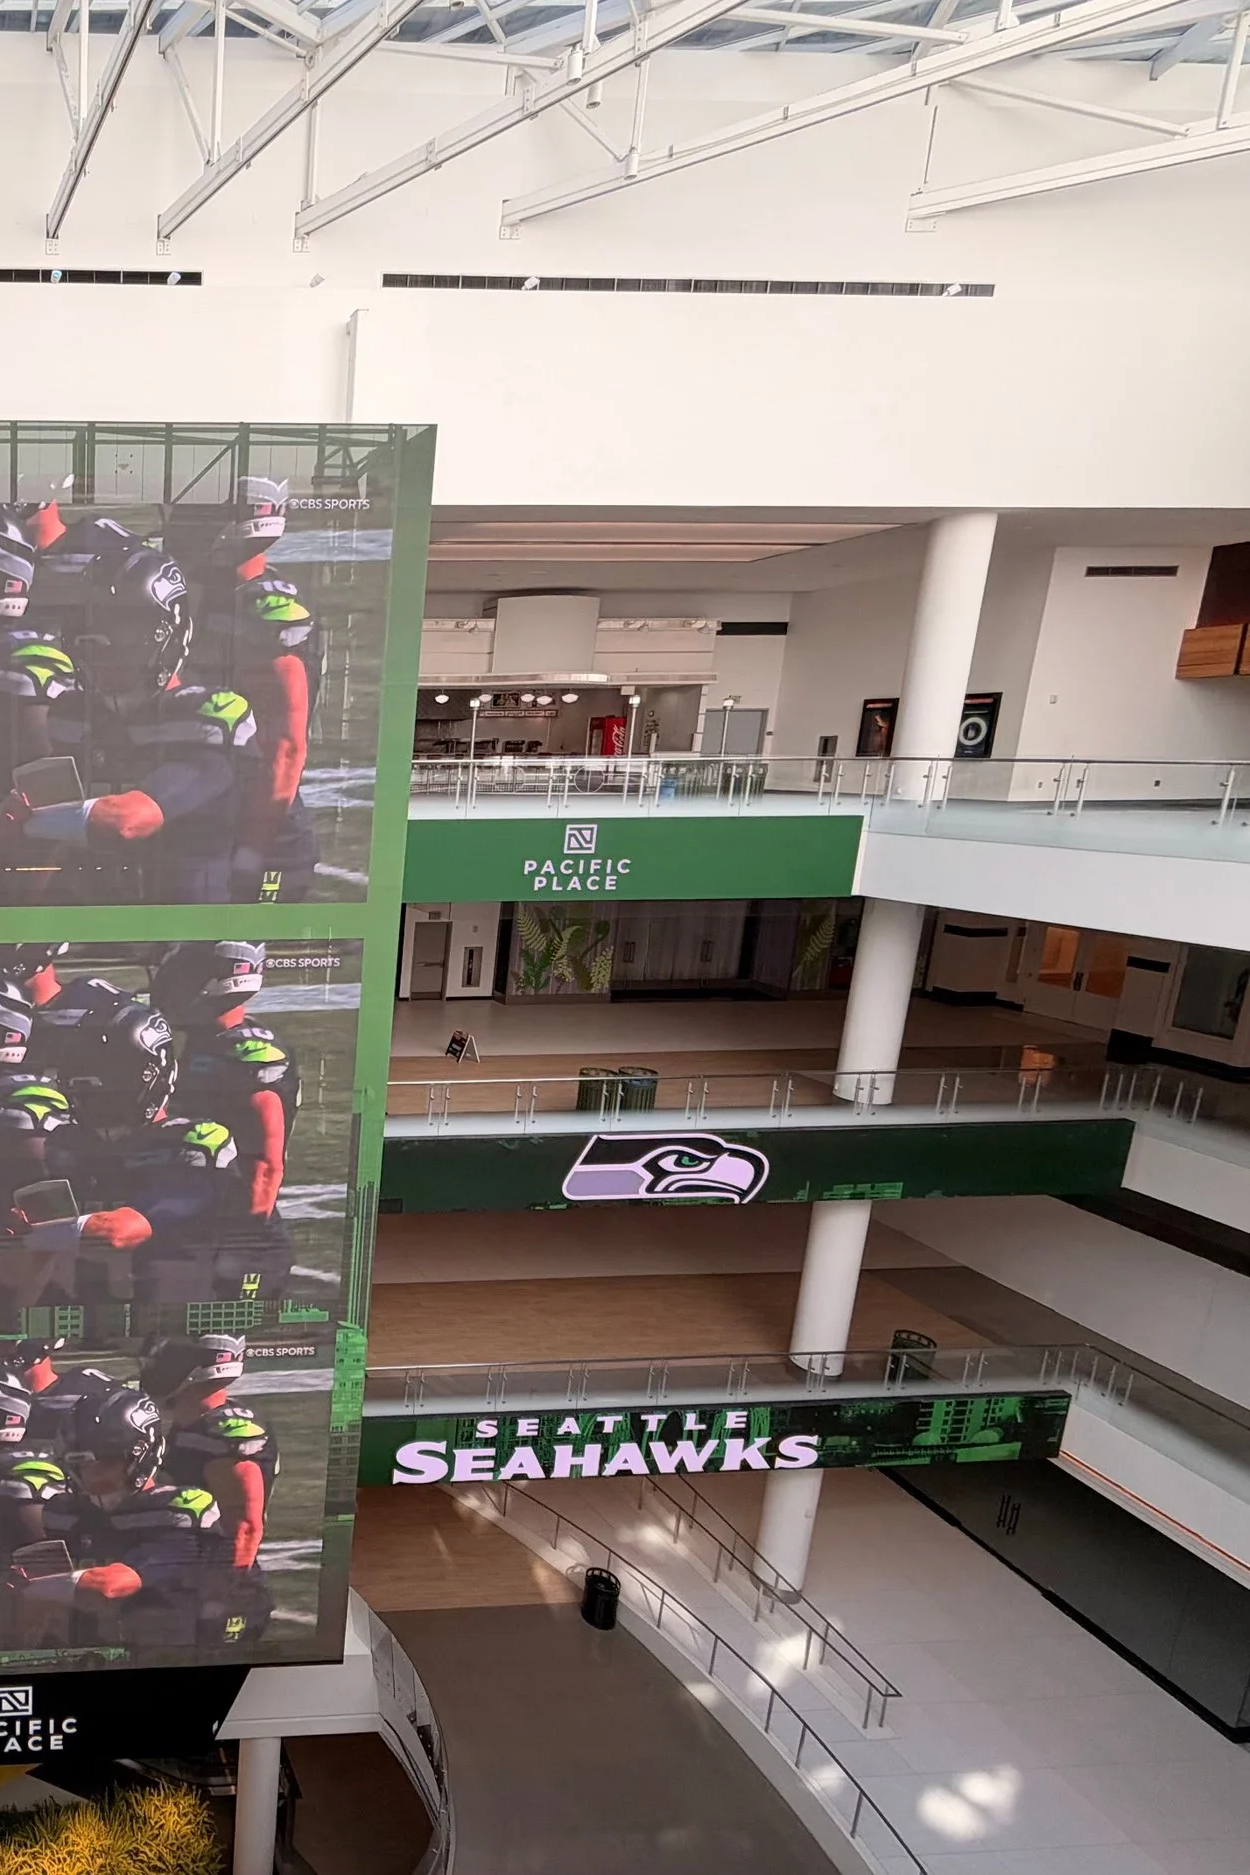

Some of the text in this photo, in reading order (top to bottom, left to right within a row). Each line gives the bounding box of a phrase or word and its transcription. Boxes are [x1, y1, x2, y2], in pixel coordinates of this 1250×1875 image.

[298, 499, 370, 511] CBS SPORTS
[524, 858, 631, 875] PACIFIC
[534, 876, 617, 891] PLACE
[275, 957, 341, 968] CBS SPORTS
[254, 1346, 315, 1357] CBS SPORTS
[475, 1411, 749, 1438] SEATTLE
[392, 1434, 819, 1485] SEAHAWKS
